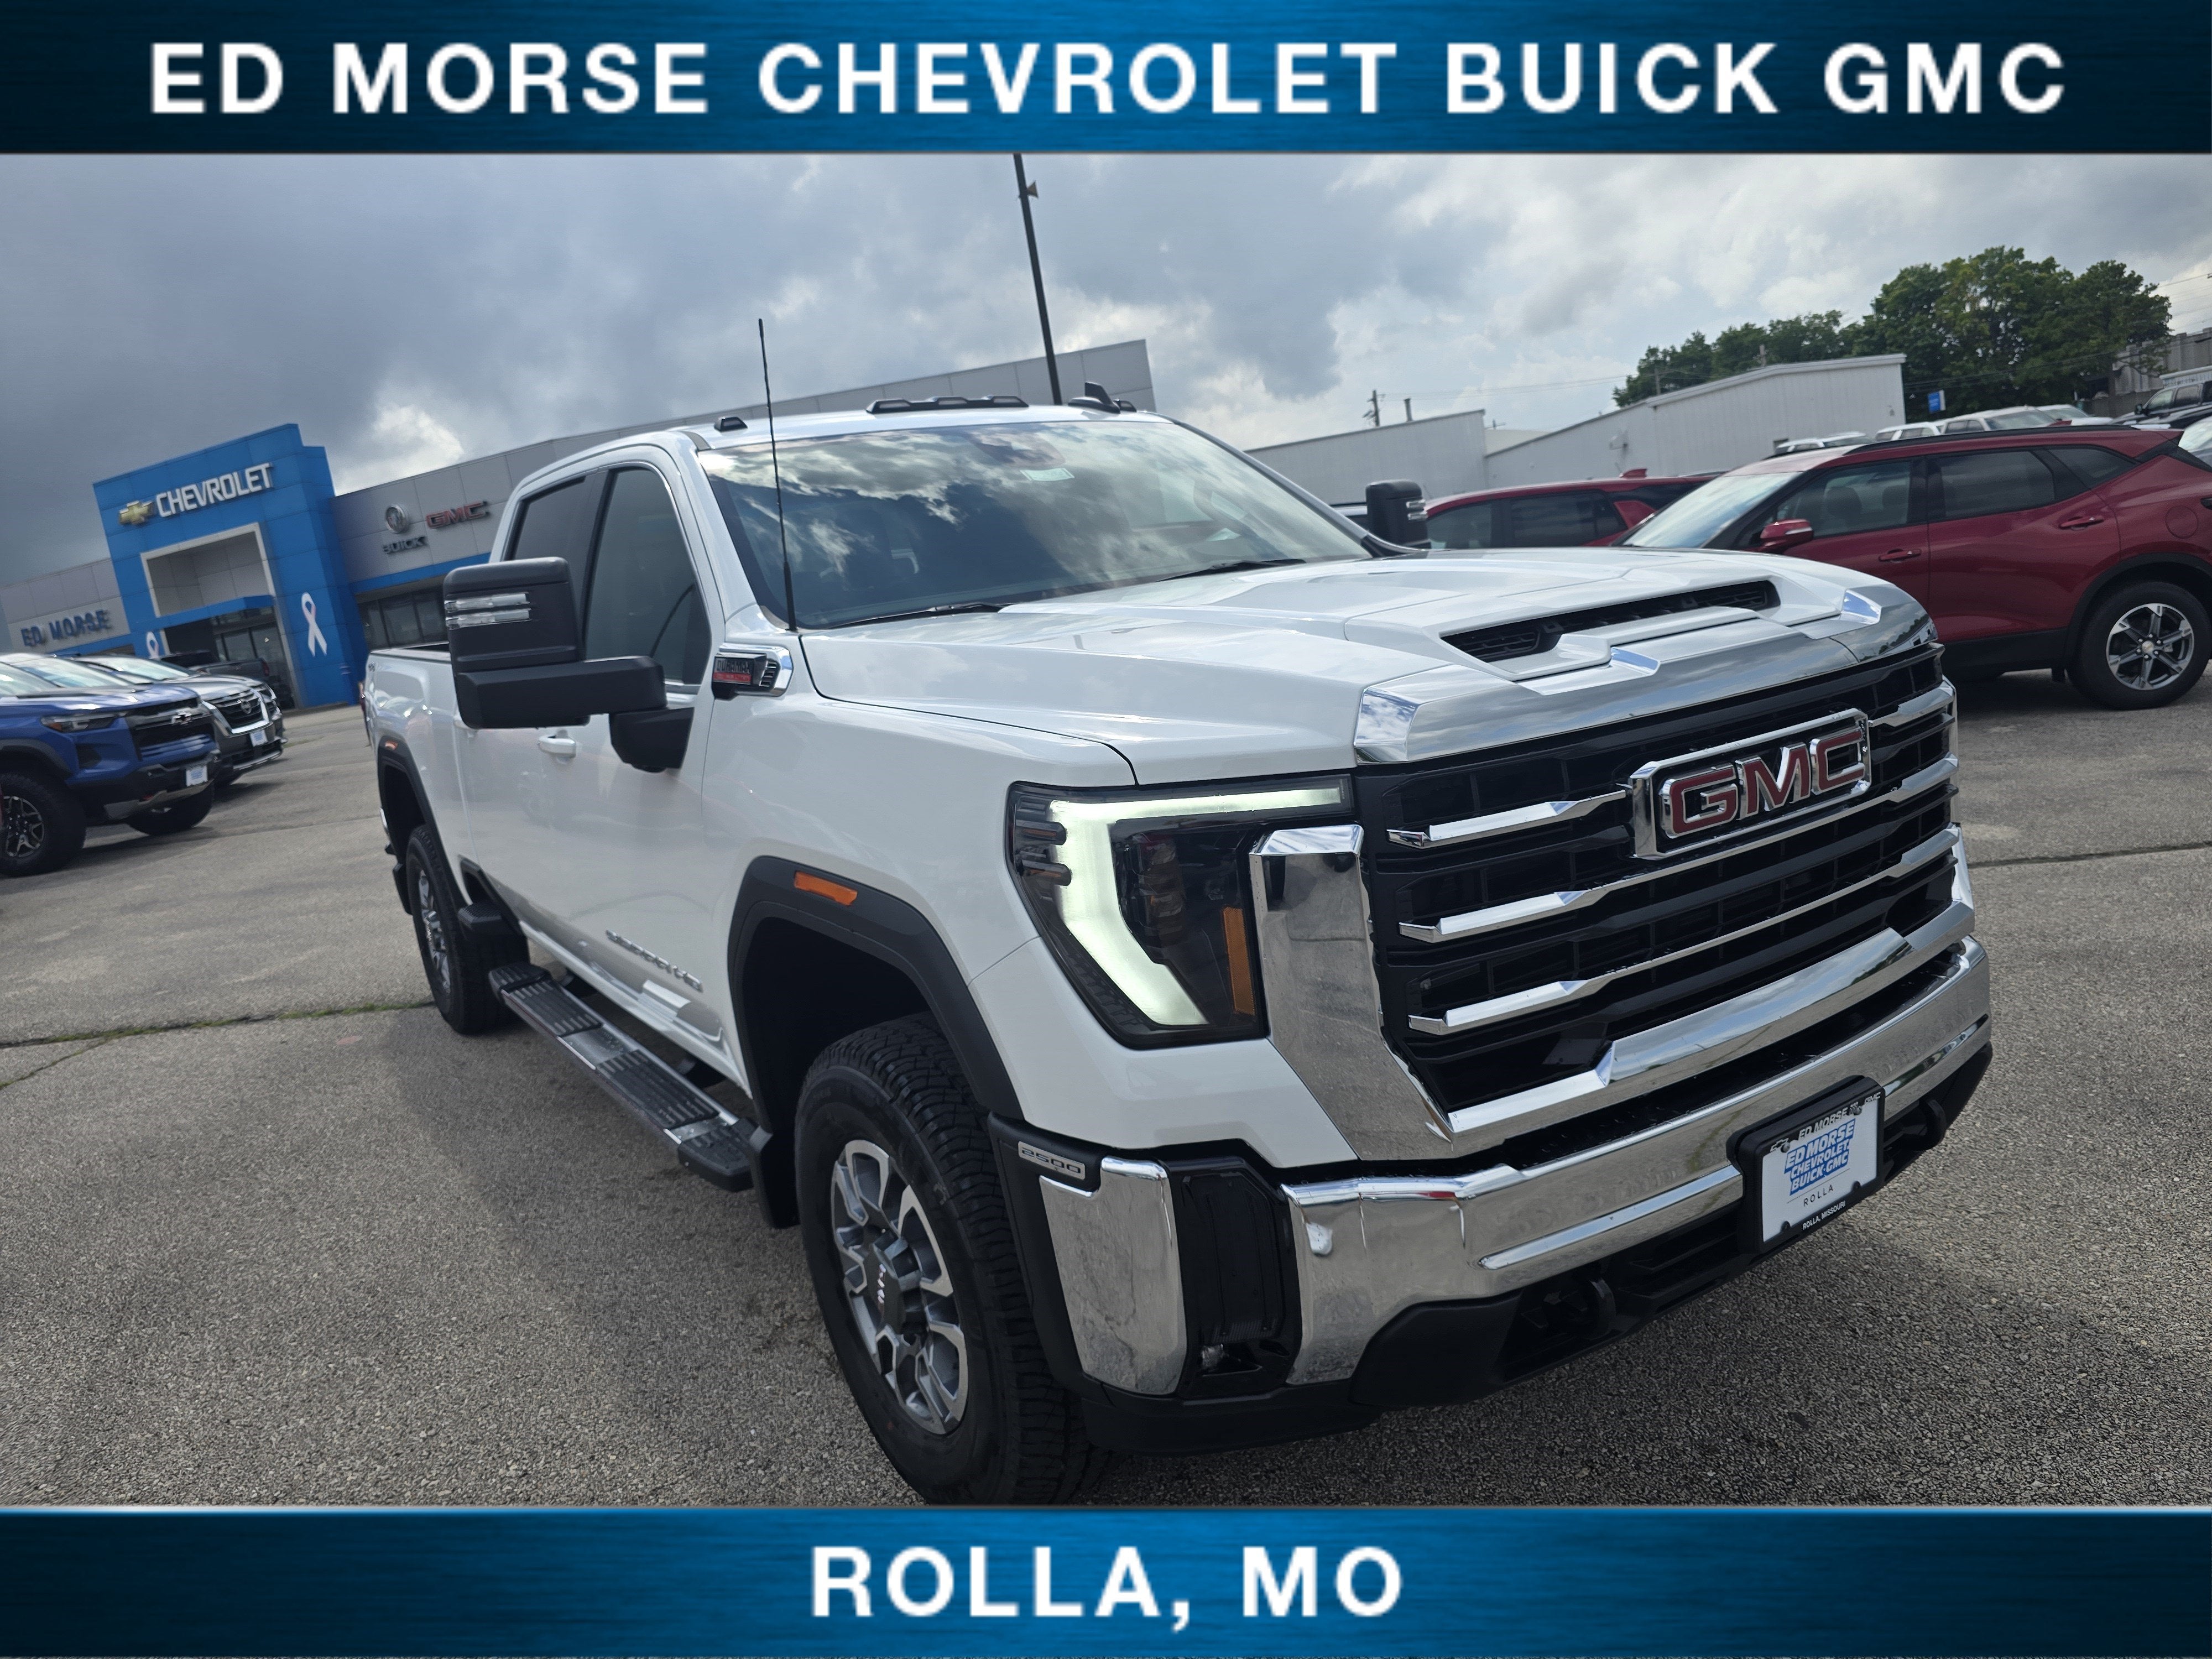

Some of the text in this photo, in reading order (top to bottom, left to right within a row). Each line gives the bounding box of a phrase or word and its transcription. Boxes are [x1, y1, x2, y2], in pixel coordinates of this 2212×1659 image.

[156, 462, 270, 518] CHEVROLET
[426, 501, 490, 529] GMC
[383, 536, 427, 554] BUICK
[21, 610, 109, 646] ED MORSE
[1660, 726, 1865, 839] GMC
[1798, 1107, 1848, 1140] ED MORSE
[1021, 1147, 1082, 1174] 2500
[1785, 1119, 1855, 1170] ED MORSE
[1791, 1139, 1849, 1178] CHEVROLET
[1803, 1184, 1834, 1207] ROLLA
